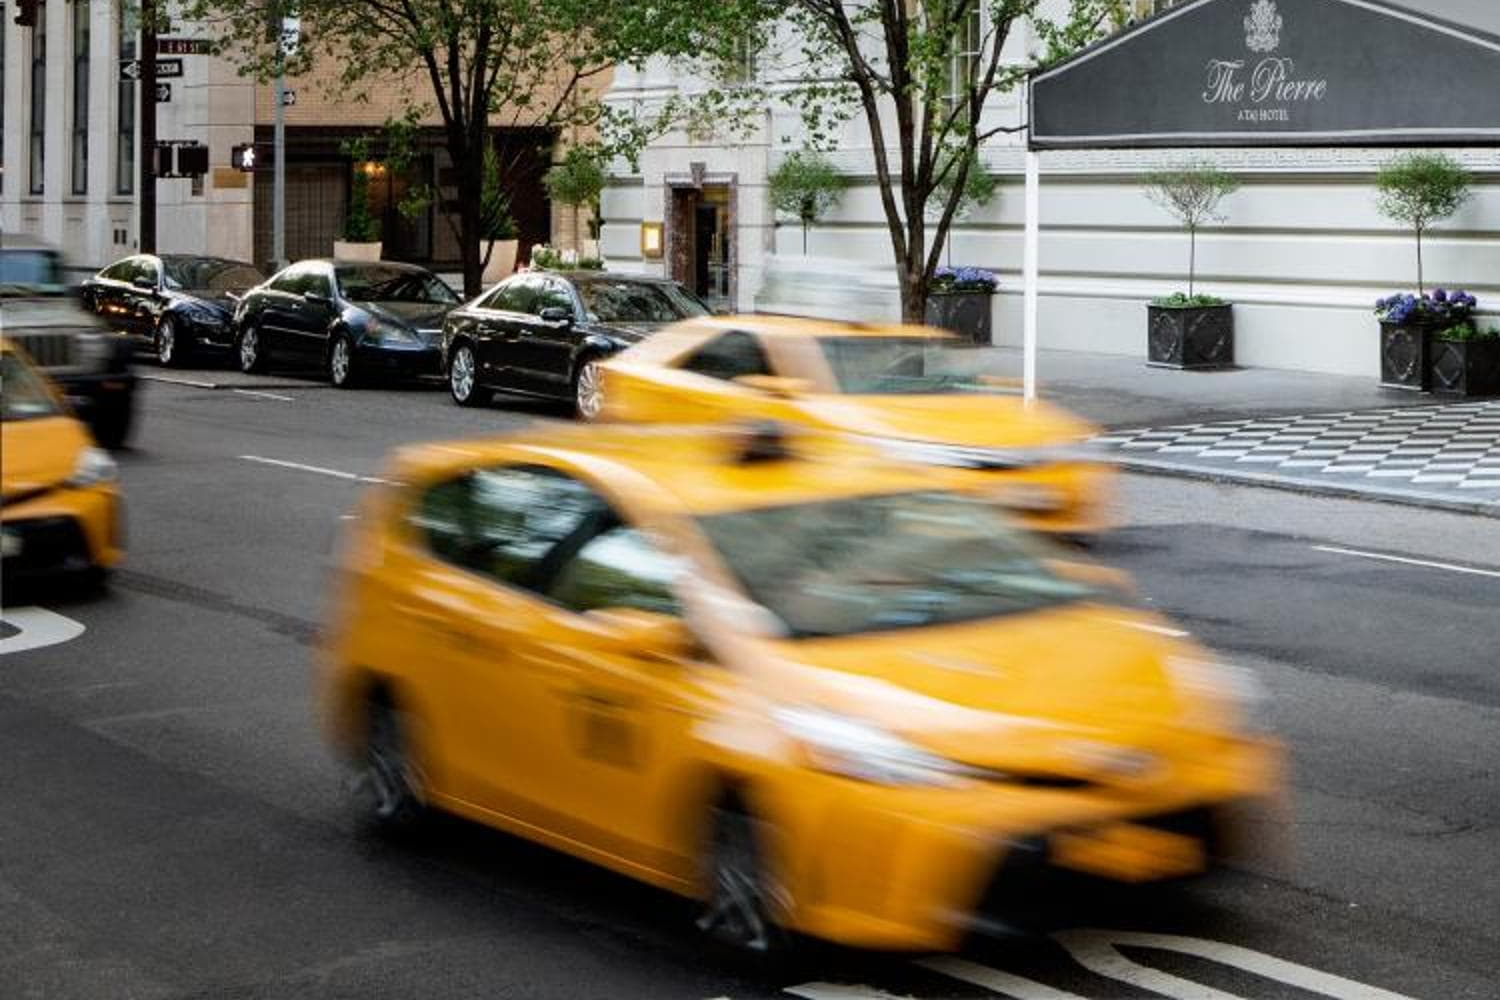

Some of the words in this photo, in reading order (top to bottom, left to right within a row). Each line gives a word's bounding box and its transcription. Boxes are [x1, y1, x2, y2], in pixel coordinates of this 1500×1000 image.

[1202, 58, 1245, 103] The
[1249, 56, 1328, 102] Pierre
[1259, 108, 1290, 121] HOTEL
